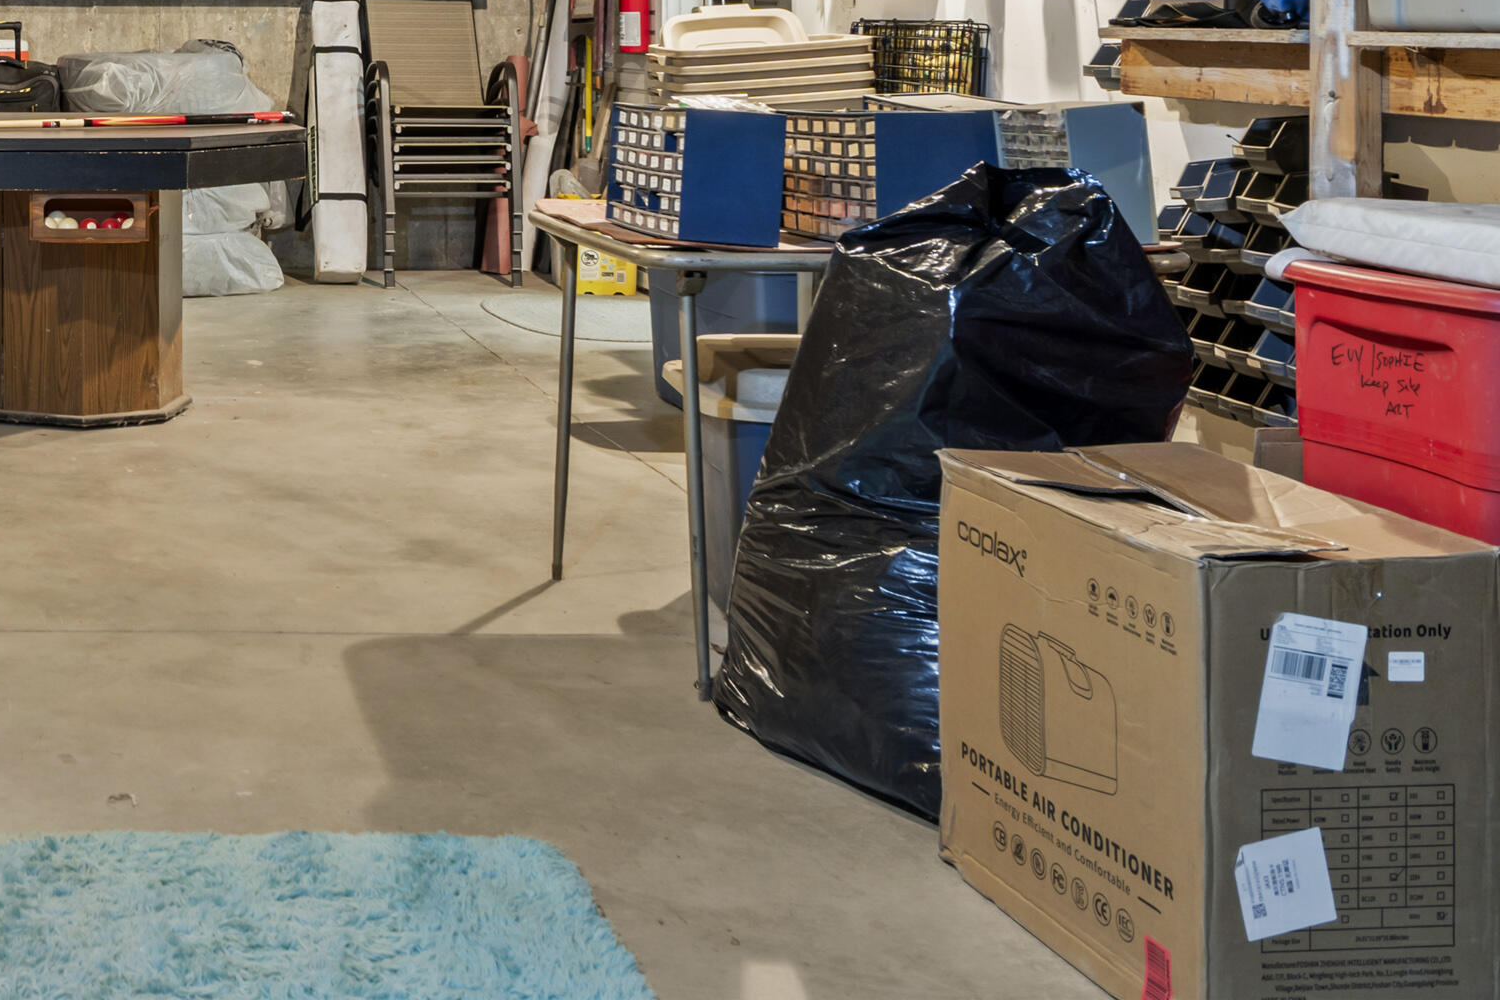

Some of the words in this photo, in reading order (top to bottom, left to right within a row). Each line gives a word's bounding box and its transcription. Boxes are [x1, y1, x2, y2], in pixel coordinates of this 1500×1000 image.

[1385, 402, 1414, 418] ART
[958, 520, 1024, 577] coplax
[1416, 623, 1451, 640] Only
[961, 741, 1028, 802] PORTABLE
[1032, 790, 1056, 823] AIR
[1061, 810, 1174, 901] CONDITIONER
[994, 792, 1020, 822] Energy
[1022, 812, 1054, 844] Efficient
[1056, 837, 1073, 856] and
[1074, 849, 1131, 896] Comfortable
